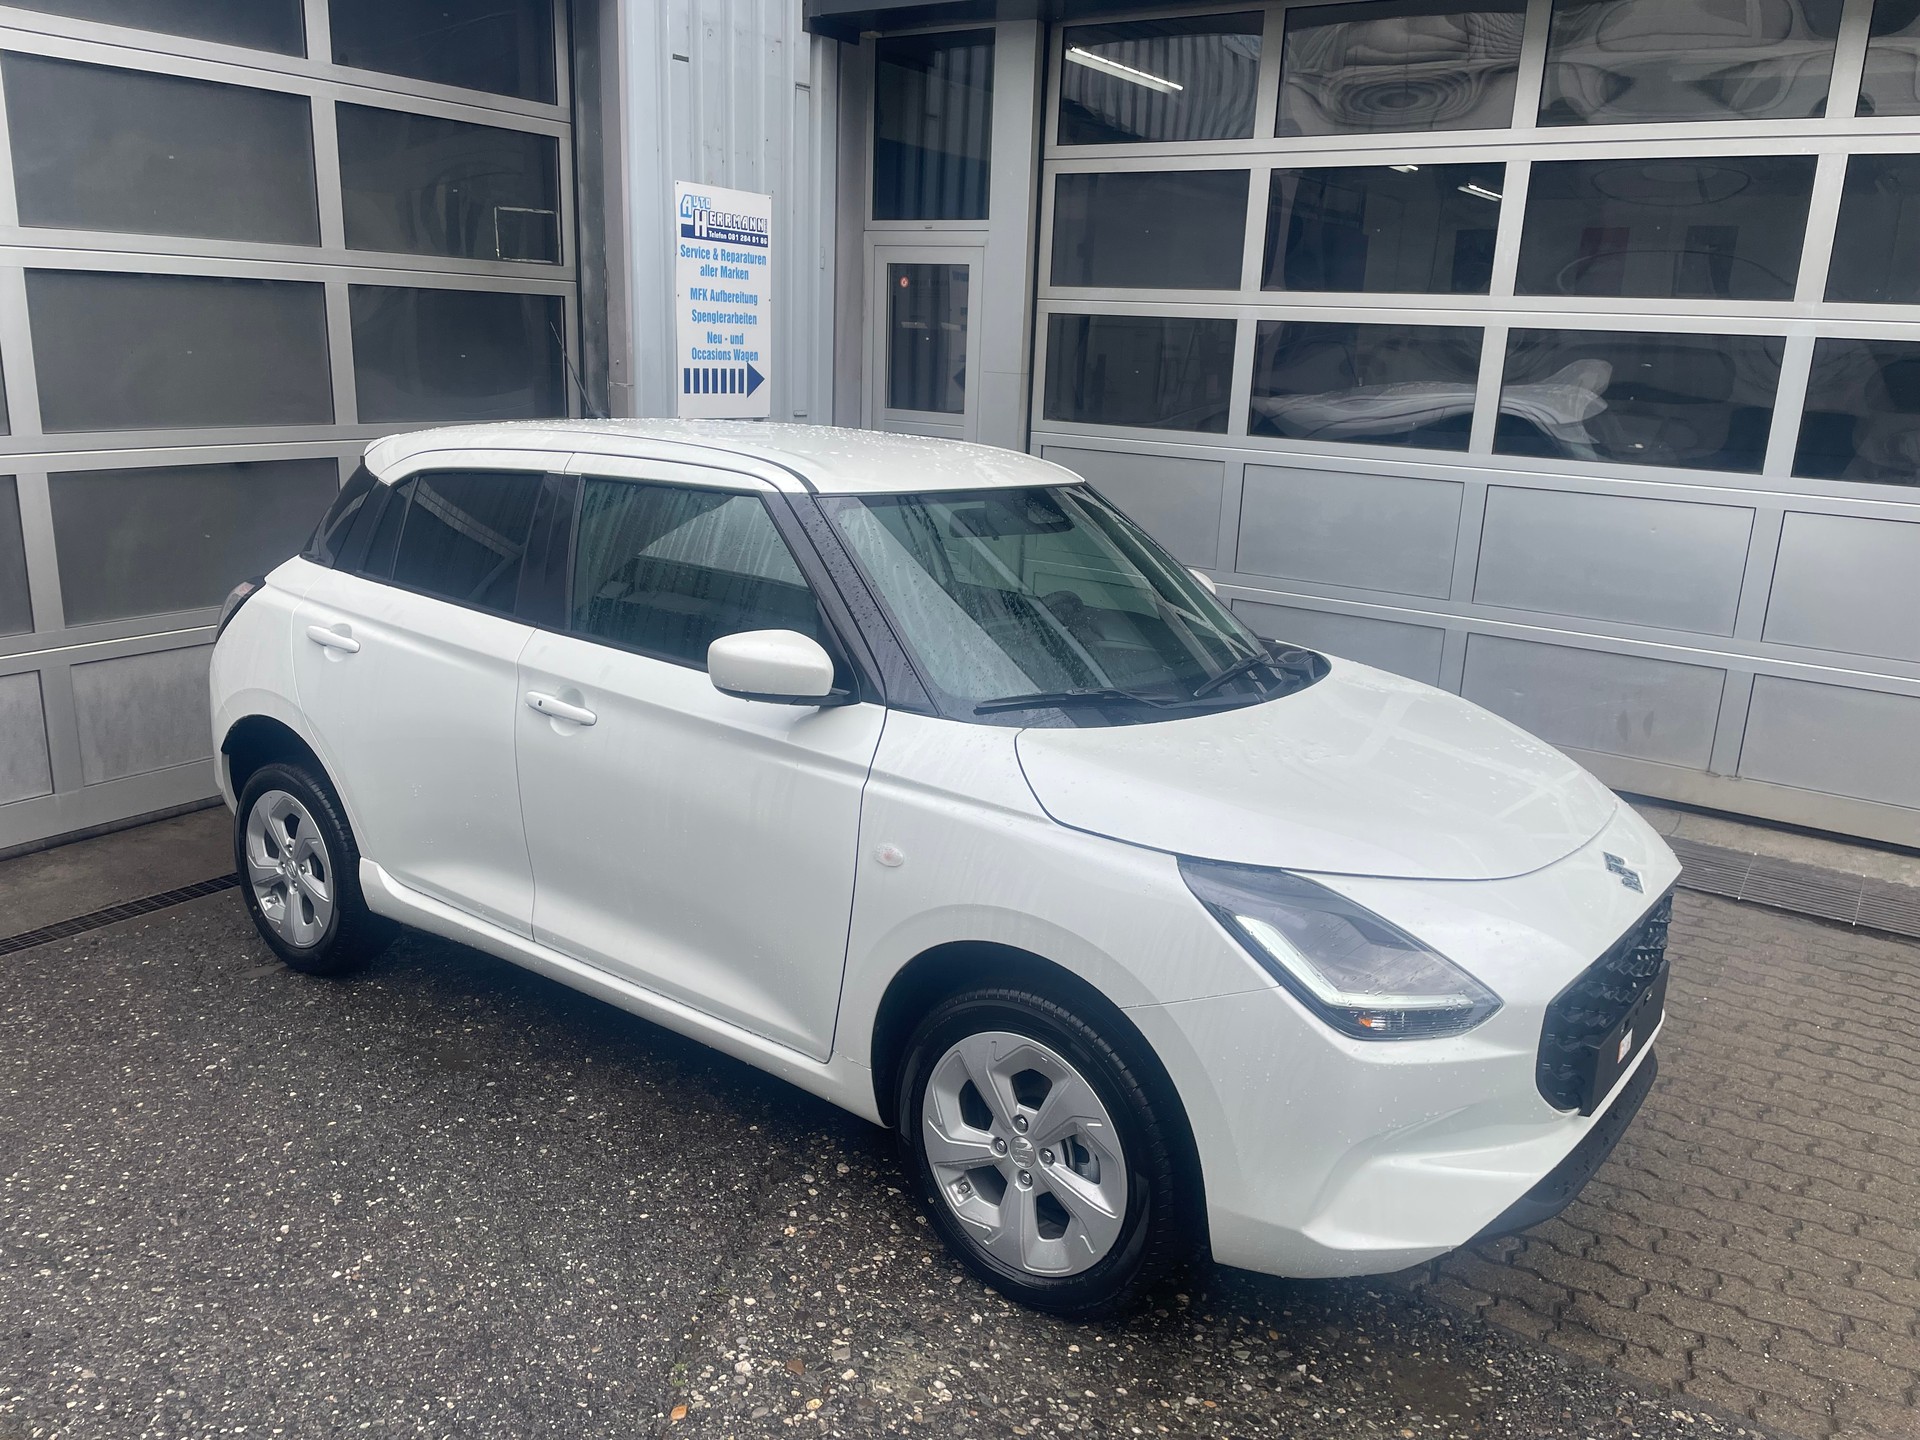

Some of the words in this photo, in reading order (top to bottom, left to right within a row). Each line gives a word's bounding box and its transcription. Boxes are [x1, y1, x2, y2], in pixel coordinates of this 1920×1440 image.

[680, 194, 711, 218] AUTO
[693, 209, 764, 237] HERRMANN
[708, 230, 727, 240] Telefon
[680, 244, 710, 260] Service
[712, 247, 718, 261] &
[720, 248, 766, 266] Reparaturen
[700, 264, 718, 278] aller
[720, 265, 749, 280] Marken
[690, 287, 708, 301] MFK
[710, 289, 758, 306] Aufbereitung
[691, 309, 757, 325] Spenglerarbeiten
[707, 331, 722, 344] Neu
[730, 333, 744, 345] und
[691, 347, 731, 361] Occasions
[733, 348, 759, 363] Wagen
